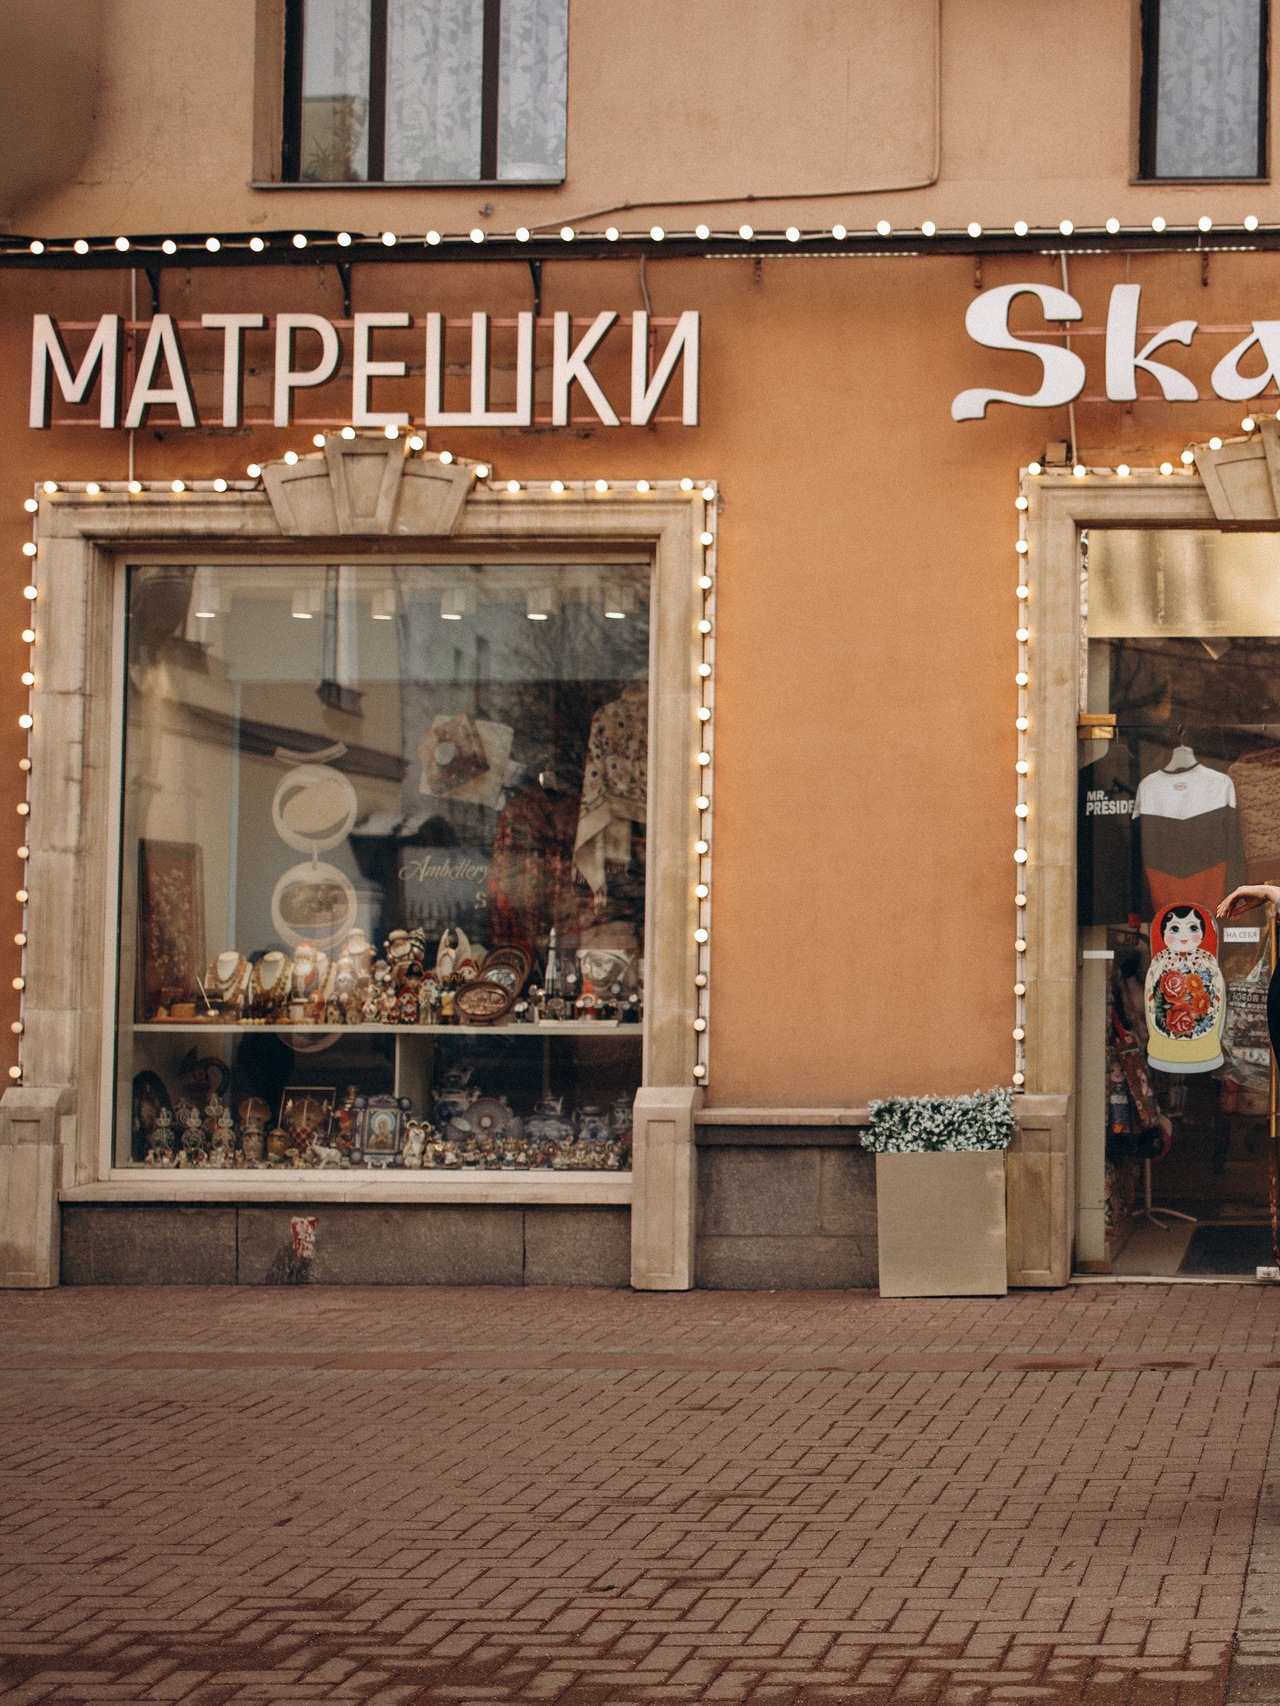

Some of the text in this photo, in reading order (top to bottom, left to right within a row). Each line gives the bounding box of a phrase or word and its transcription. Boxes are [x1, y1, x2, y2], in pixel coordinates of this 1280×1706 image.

[29, 311, 699, 429] МАТРЕШКИ
[1086, 790, 1108, 802] MR.
[1226, 931, 1258, 939] НА СЕБЯ
